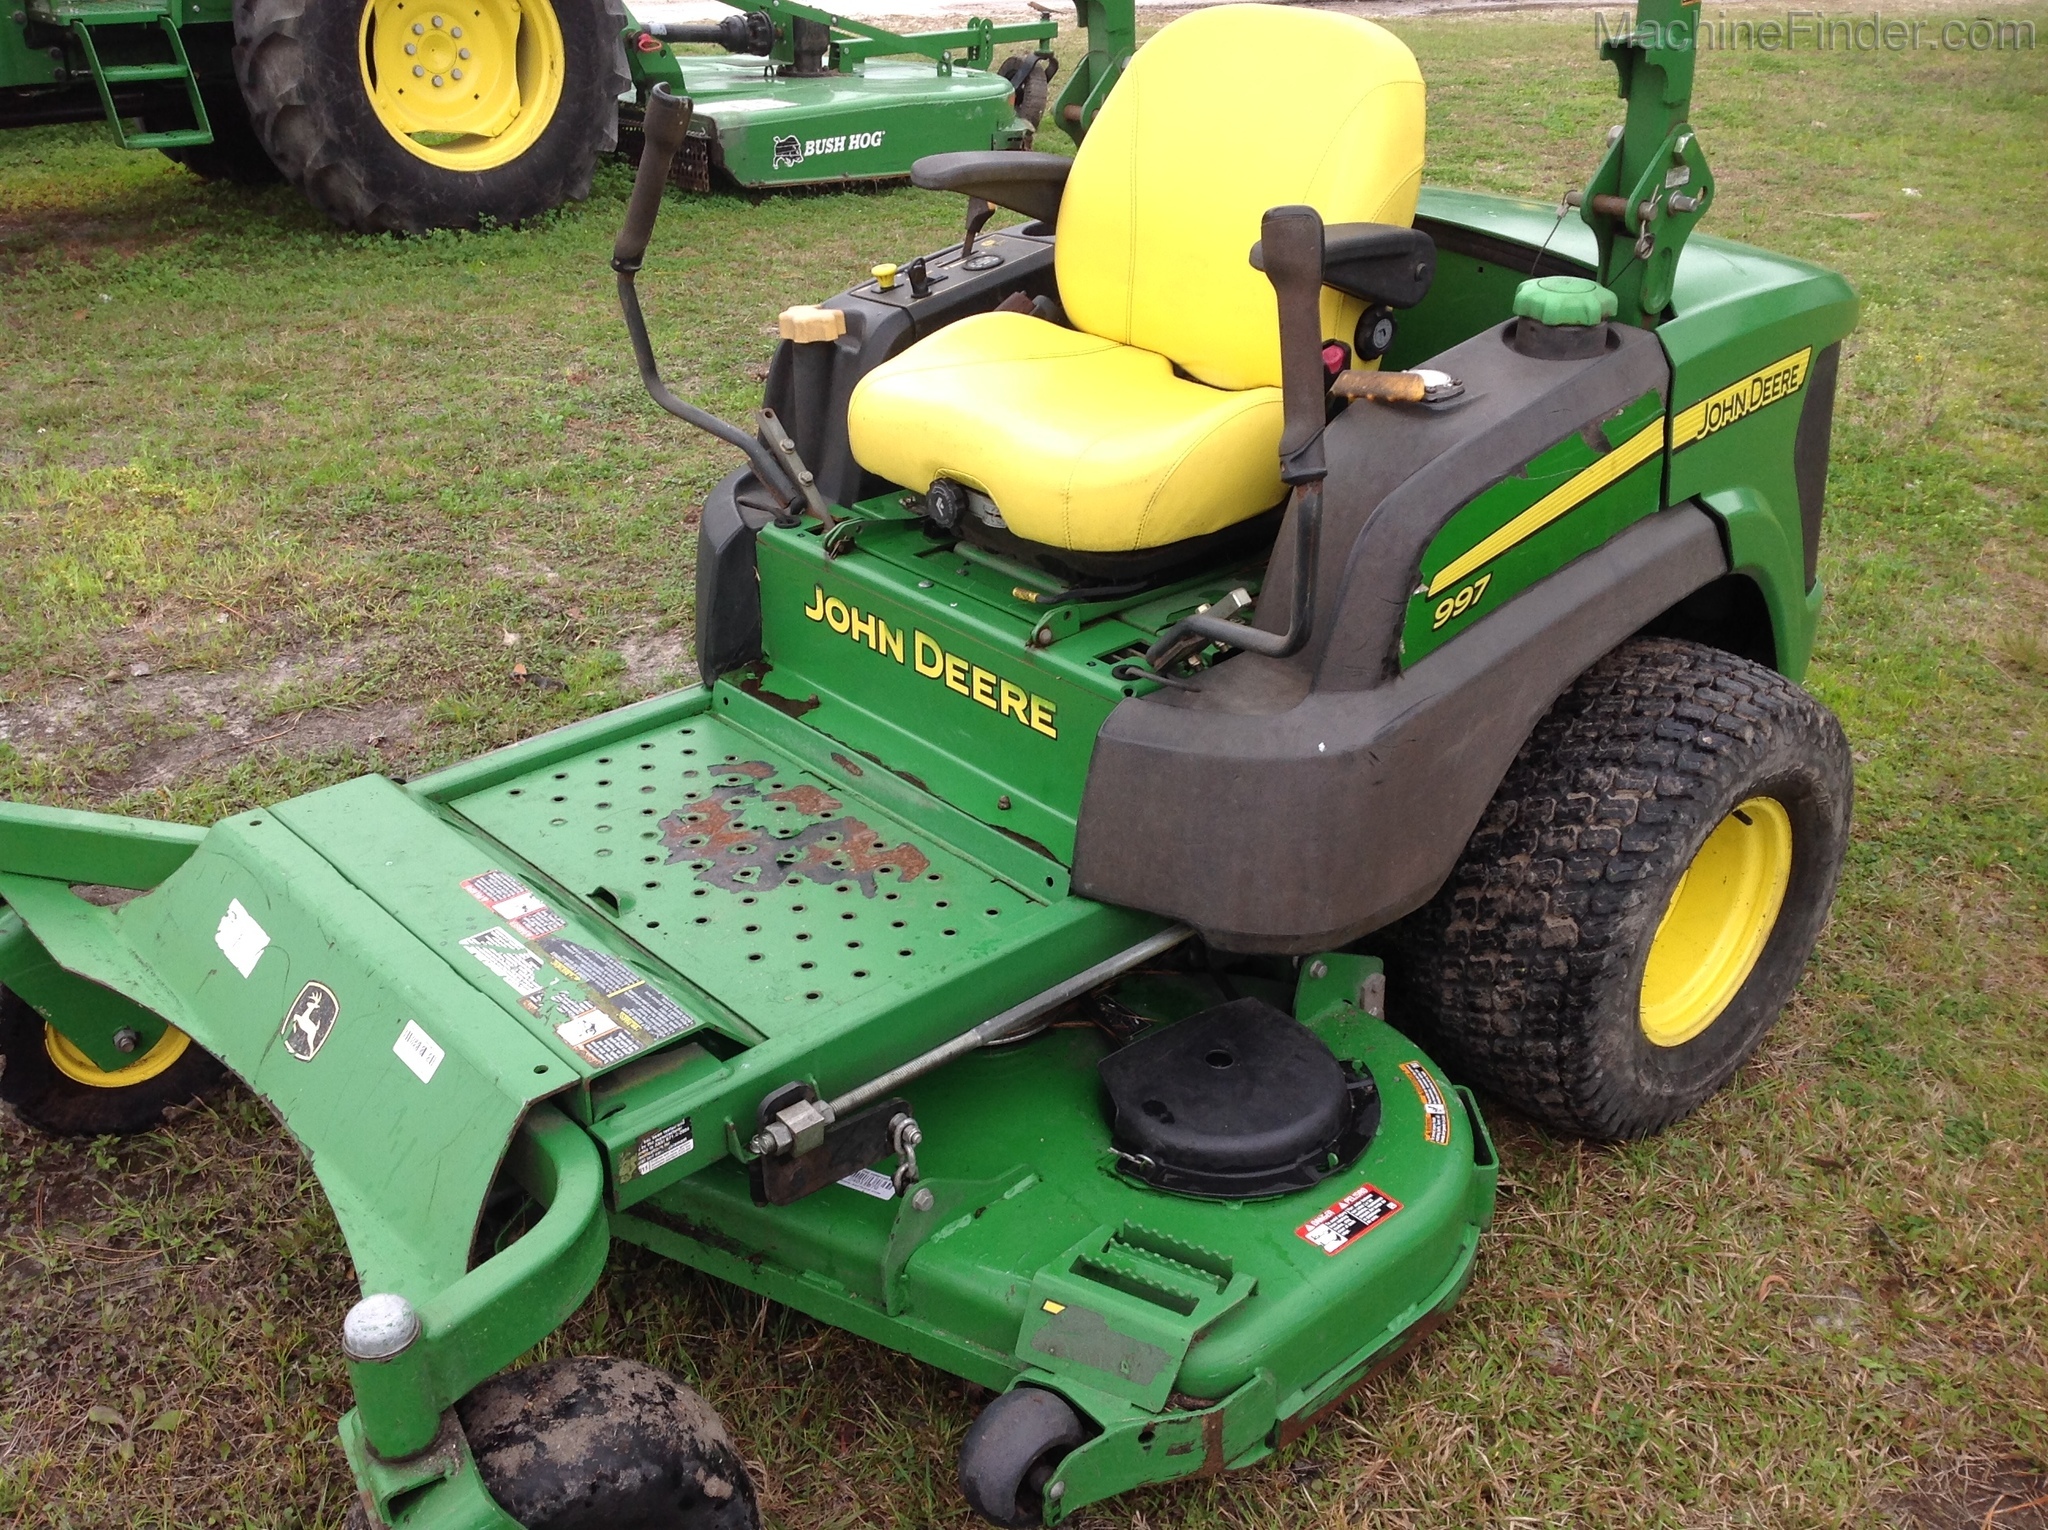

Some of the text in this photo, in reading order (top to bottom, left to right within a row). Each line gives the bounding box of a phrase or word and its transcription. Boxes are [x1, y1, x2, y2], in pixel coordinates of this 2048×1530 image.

[804, 131, 884, 157] BUSH HOG
[1697, 364, 1800, 437] JOHN DEERE
[1432, 571, 1493, 631] 997
[804, 582, 1058, 740] JOHN DEERE
